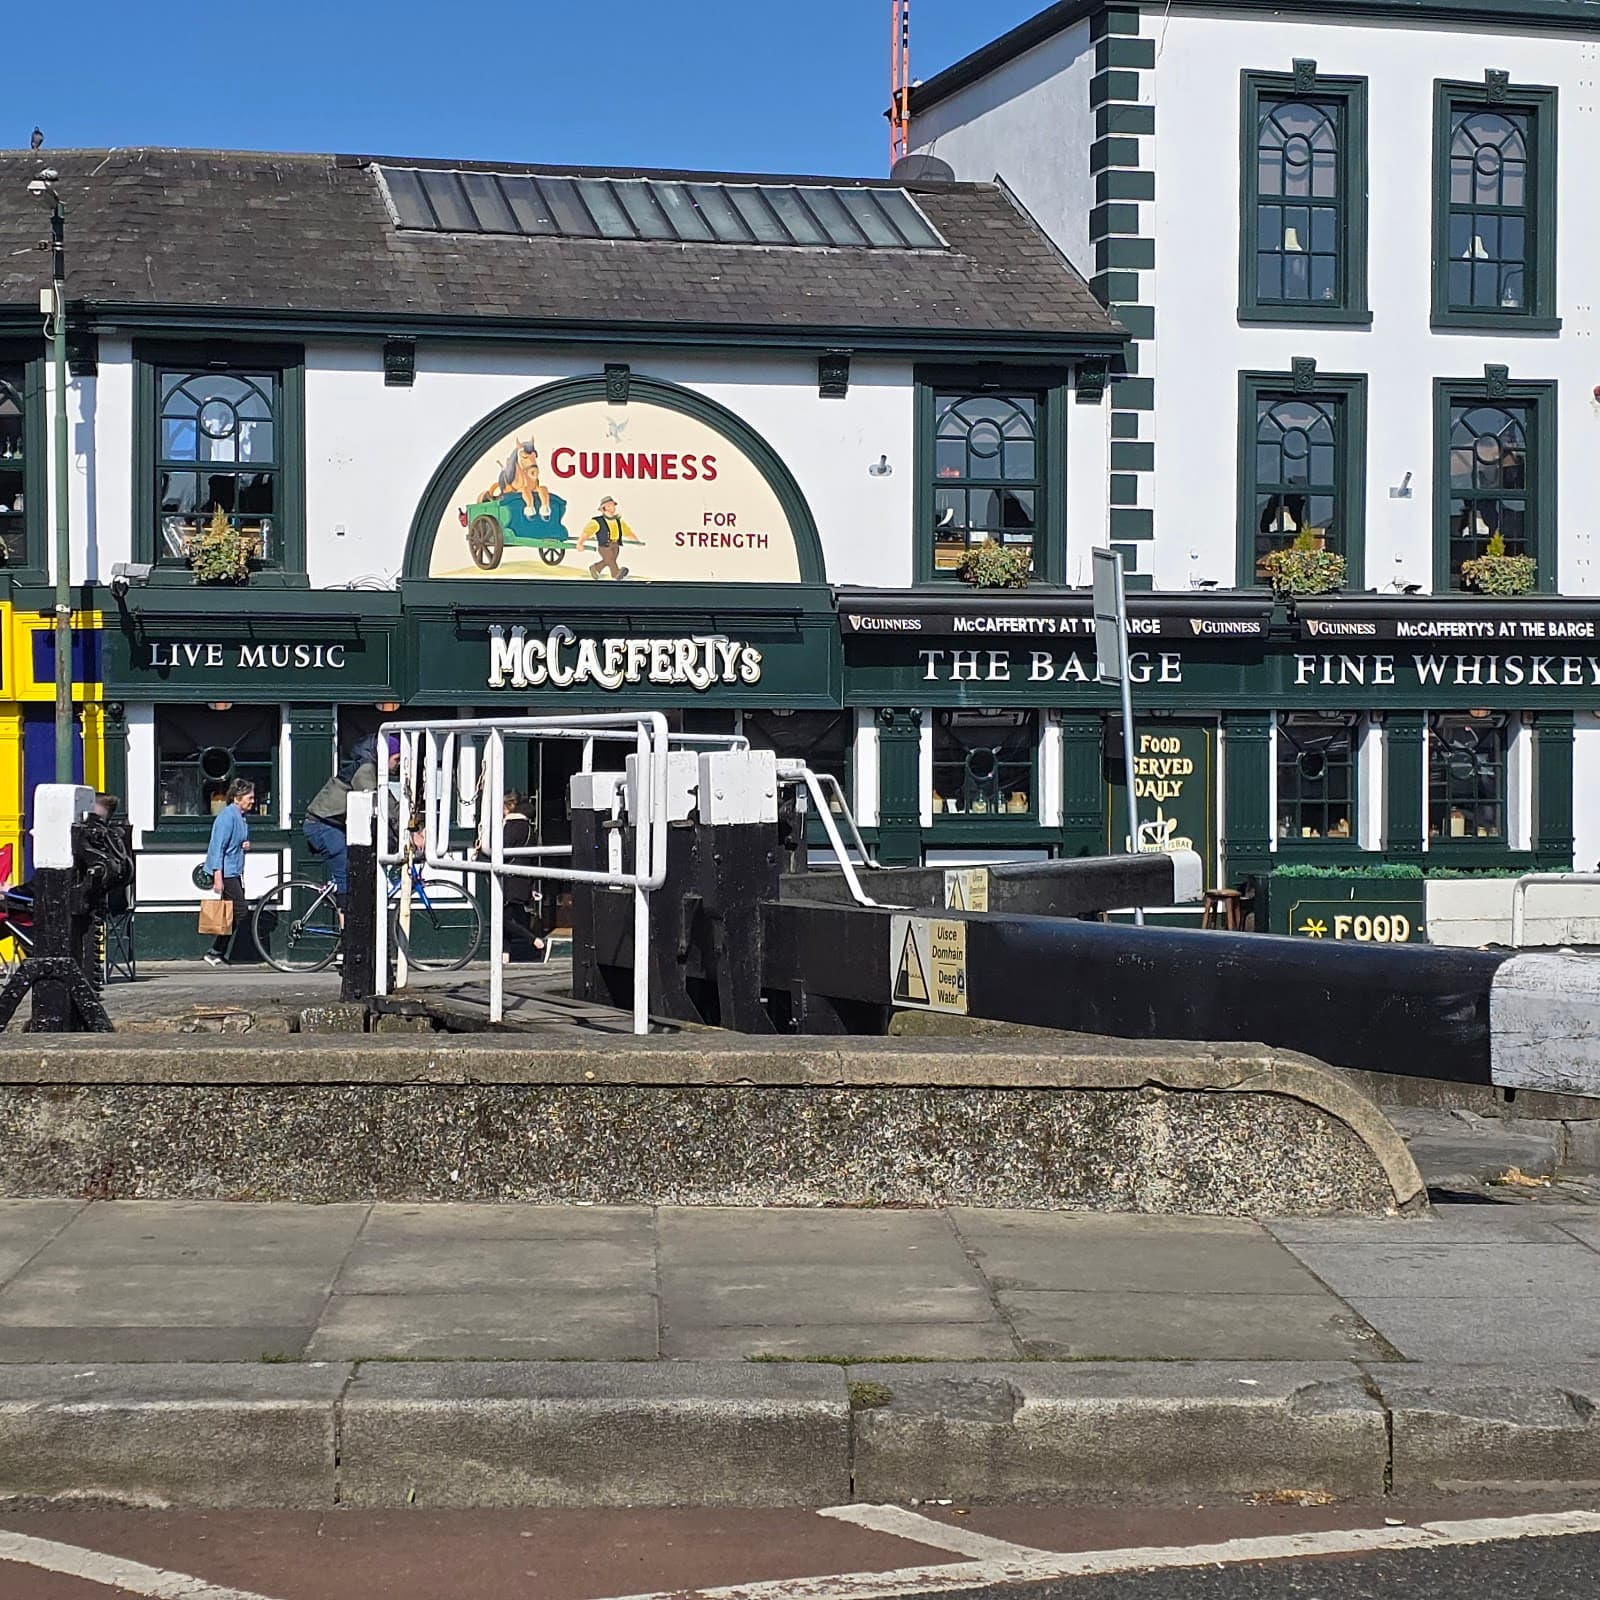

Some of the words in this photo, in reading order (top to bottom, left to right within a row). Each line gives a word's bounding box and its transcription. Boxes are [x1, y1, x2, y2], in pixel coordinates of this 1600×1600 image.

[550, 447, 718, 481] GUINNESS
[703, 512, 737, 528] FOR
[675, 531, 769, 549] STRENGTH
[861, 619, 922, 630] GUINNESS
[953, 617, 1056, 634] McCAFFERTY'S
[1059, 618, 1078, 633] AT
[1126, 619, 1160, 634] ARGE
[1202, 621, 1261, 634] GUINNESS
[1319, 622, 1376, 636] GUINNESS
[1397, 622, 1495, 637] McCAFFERTY'S
[1499, 622, 1517, 637] AT
[1520, 622, 1546, 637] THE
[1548, 622, 1595, 637] BARGE
[149, 643, 224, 667] LIVE
[238, 644, 346, 668] MUSIC
[918, 650, 1011, 681] THE
[1027, 651, 1183, 683] BAGE
[1293, 654, 1395, 685] FINE
[1140, 735, 1181, 754] FOOD
[1135, 778, 1184, 802] DAILY
[937, 927, 957, 941] Uisce
[1334, 915, 1410, 943] FOOD
[932, 945, 963, 961] Domhain
[938, 970, 957, 988] Deep
[937, 990, 958, 1005] Water
